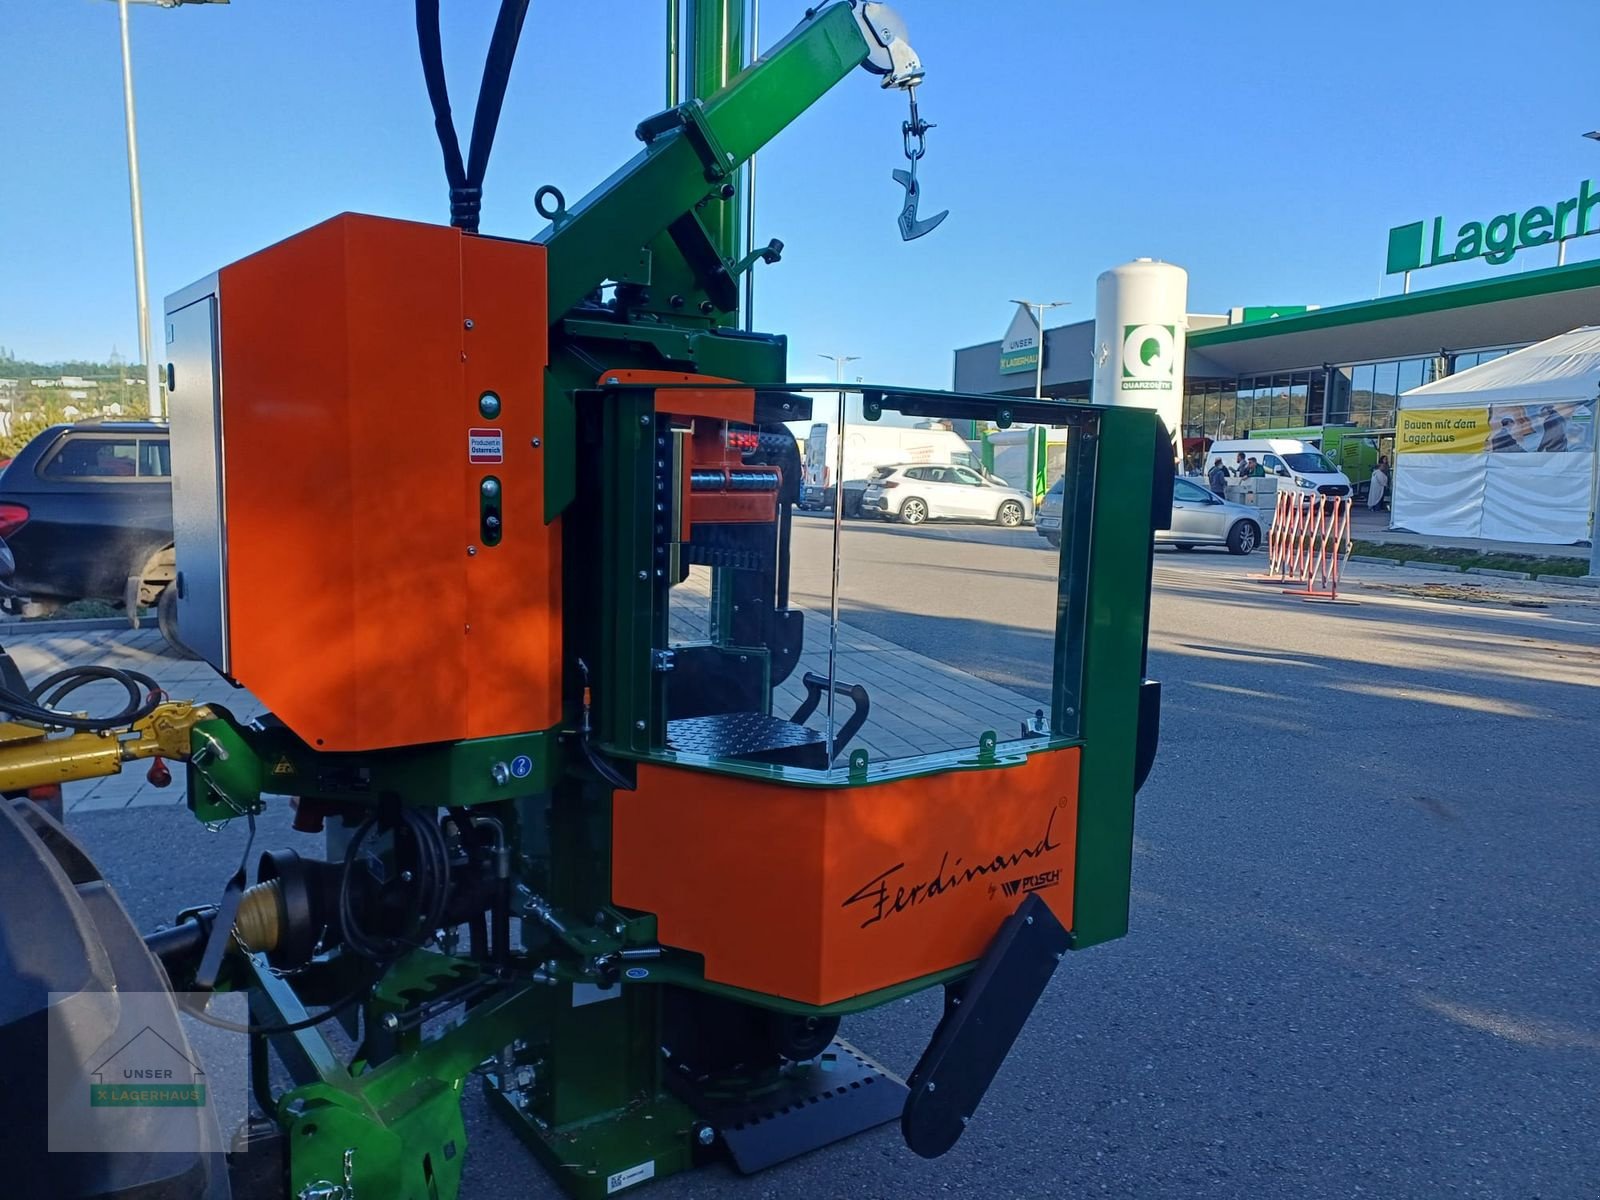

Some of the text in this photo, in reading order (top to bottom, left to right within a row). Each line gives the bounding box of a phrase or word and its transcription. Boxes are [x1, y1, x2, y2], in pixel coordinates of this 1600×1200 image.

[1010, 338, 1032, 349] UNSER
[1007, 353, 1038, 368] LAGERHAU
[1404, 419, 1476, 430] Bauen mit dem
[1403, 432, 1455, 445] Lagerhaus
[841, 806, 1061, 929] Ferdinand
